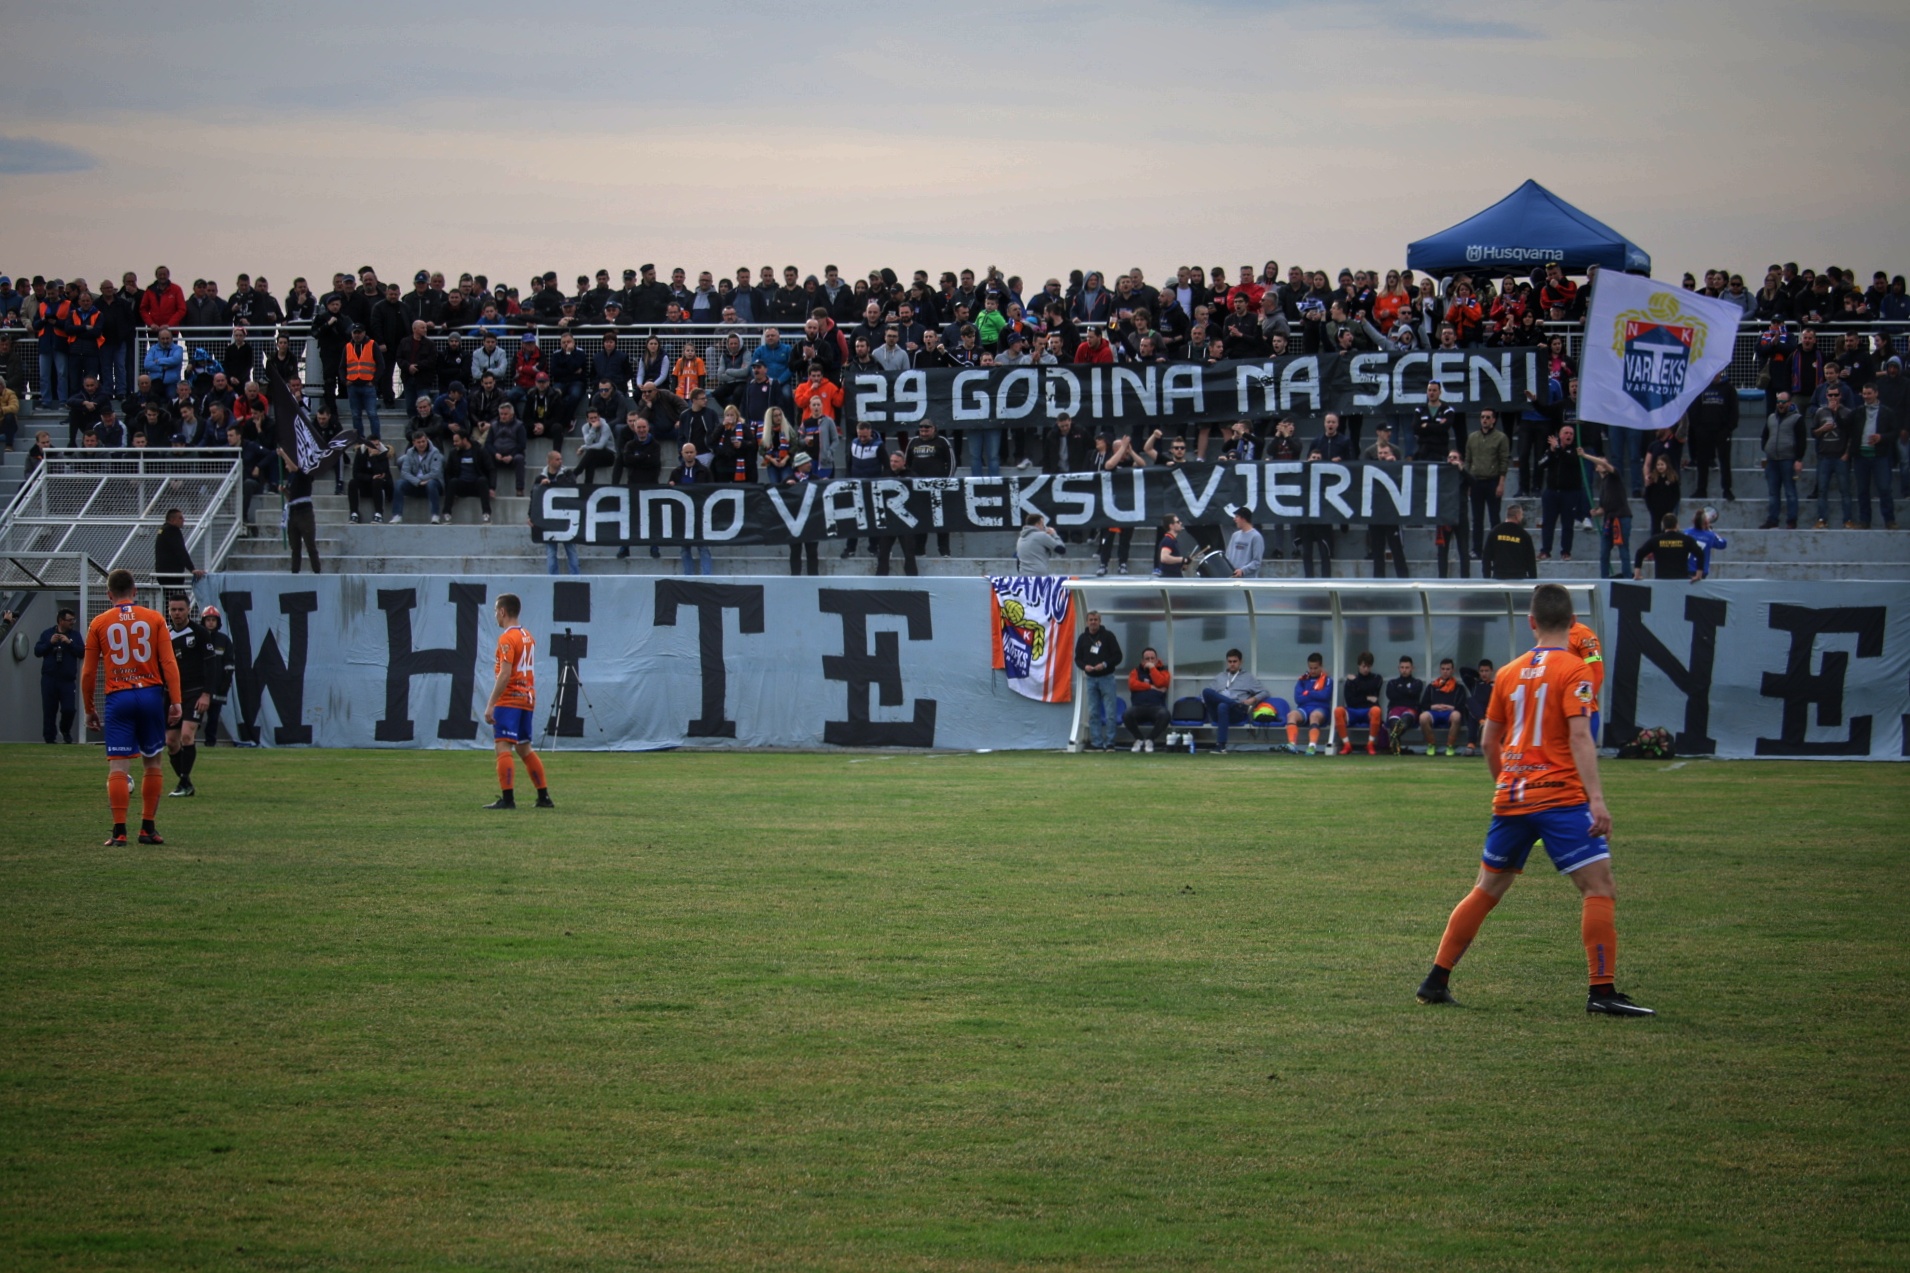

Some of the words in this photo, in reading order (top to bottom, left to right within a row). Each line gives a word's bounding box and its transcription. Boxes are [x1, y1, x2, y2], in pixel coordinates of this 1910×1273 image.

[1483, 246, 1564, 261] Husqvarna
[1627, 322, 1638, 336] N
[1681, 328, 1692, 342] K
[1625, 341, 1685, 386] VARTEKS
[855, 369, 927, 422] 29
[952, 364, 1205, 421] GODINA
[1236, 355, 1321, 413] NA
[1349, 352, 1537, 406] SCENI
[542, 486, 745, 543] SAMO
[766, 468, 1145, 537] VARTEKSU
[1171, 463, 1438, 518] VJERNI
[119, 612, 136, 622] ŠOLE
[1022, 630, 1031, 642] K
[107, 621, 152, 666] 93
[516, 641, 535, 677] 44
[1509, 682, 1548, 747] 11
